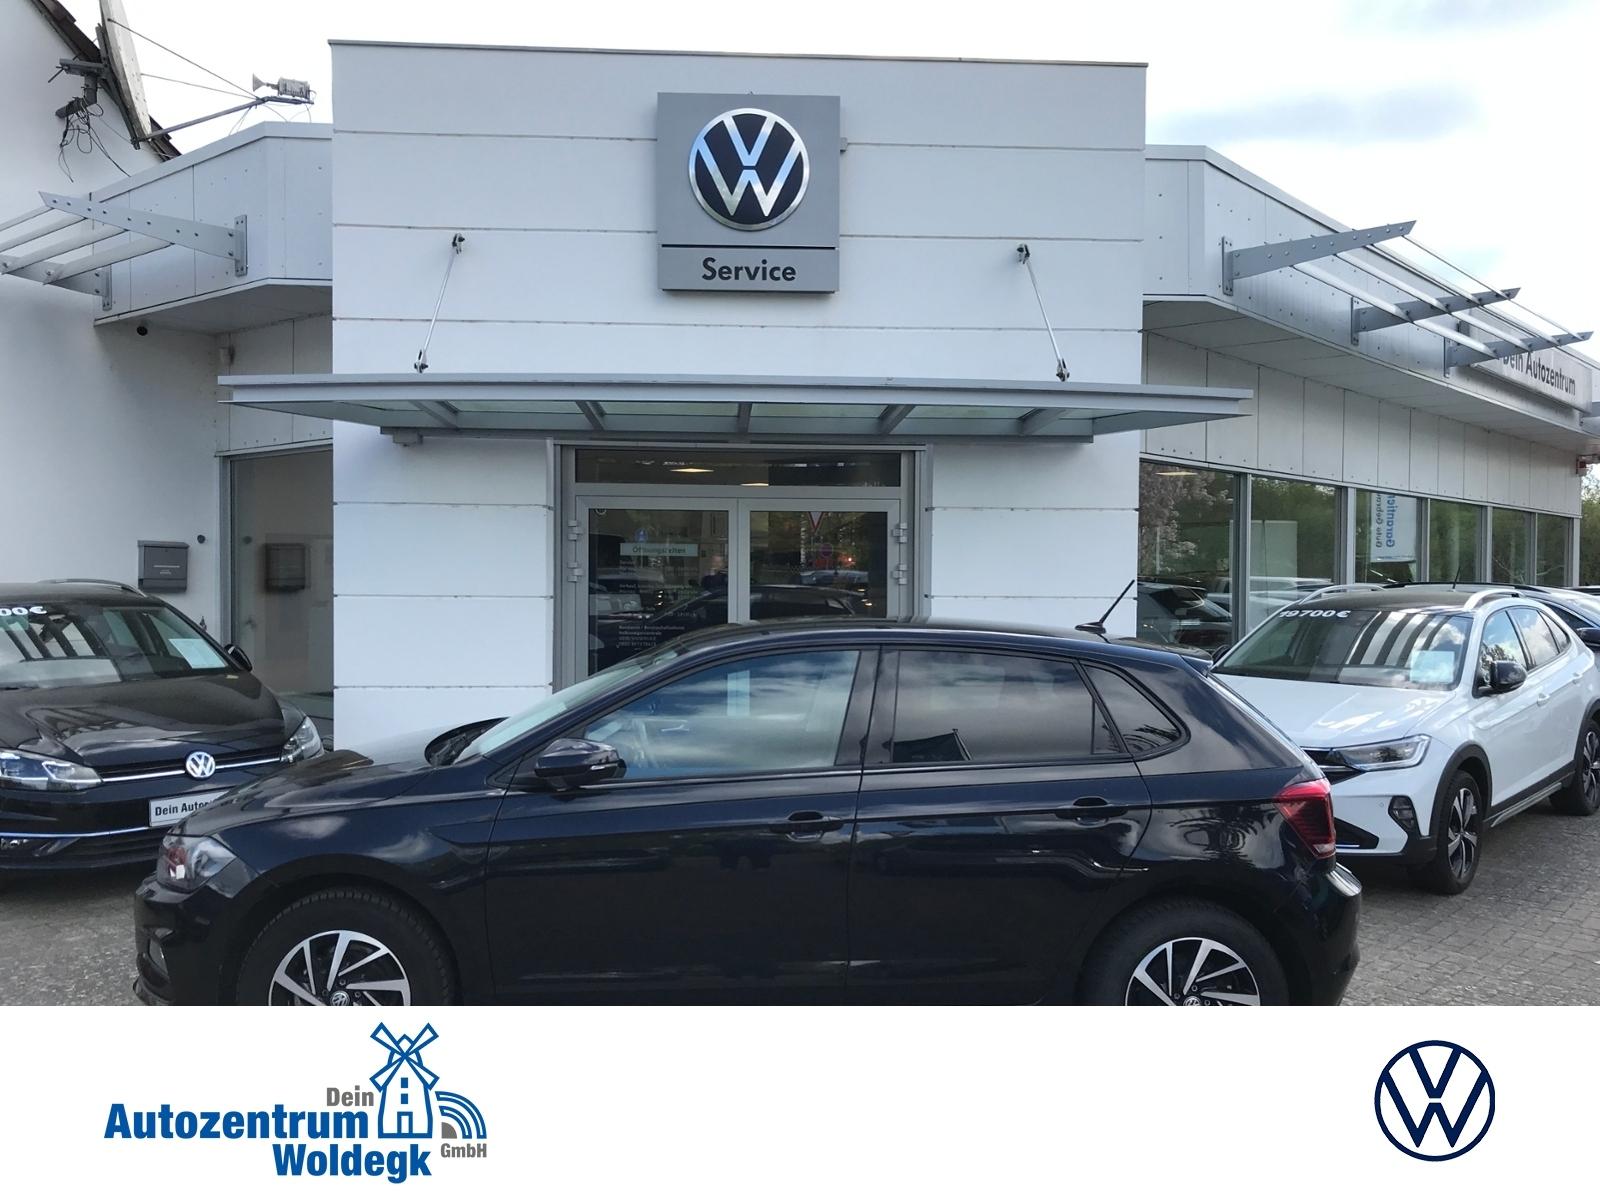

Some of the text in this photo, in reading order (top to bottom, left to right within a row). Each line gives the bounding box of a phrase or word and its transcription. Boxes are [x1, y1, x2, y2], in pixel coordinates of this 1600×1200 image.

[690, 109, 808, 226] VW
[701, 257, 797, 282] Service
[1525, 351, 1576, 396] Autozentrum
[155, 805, 179, 817] Dein
